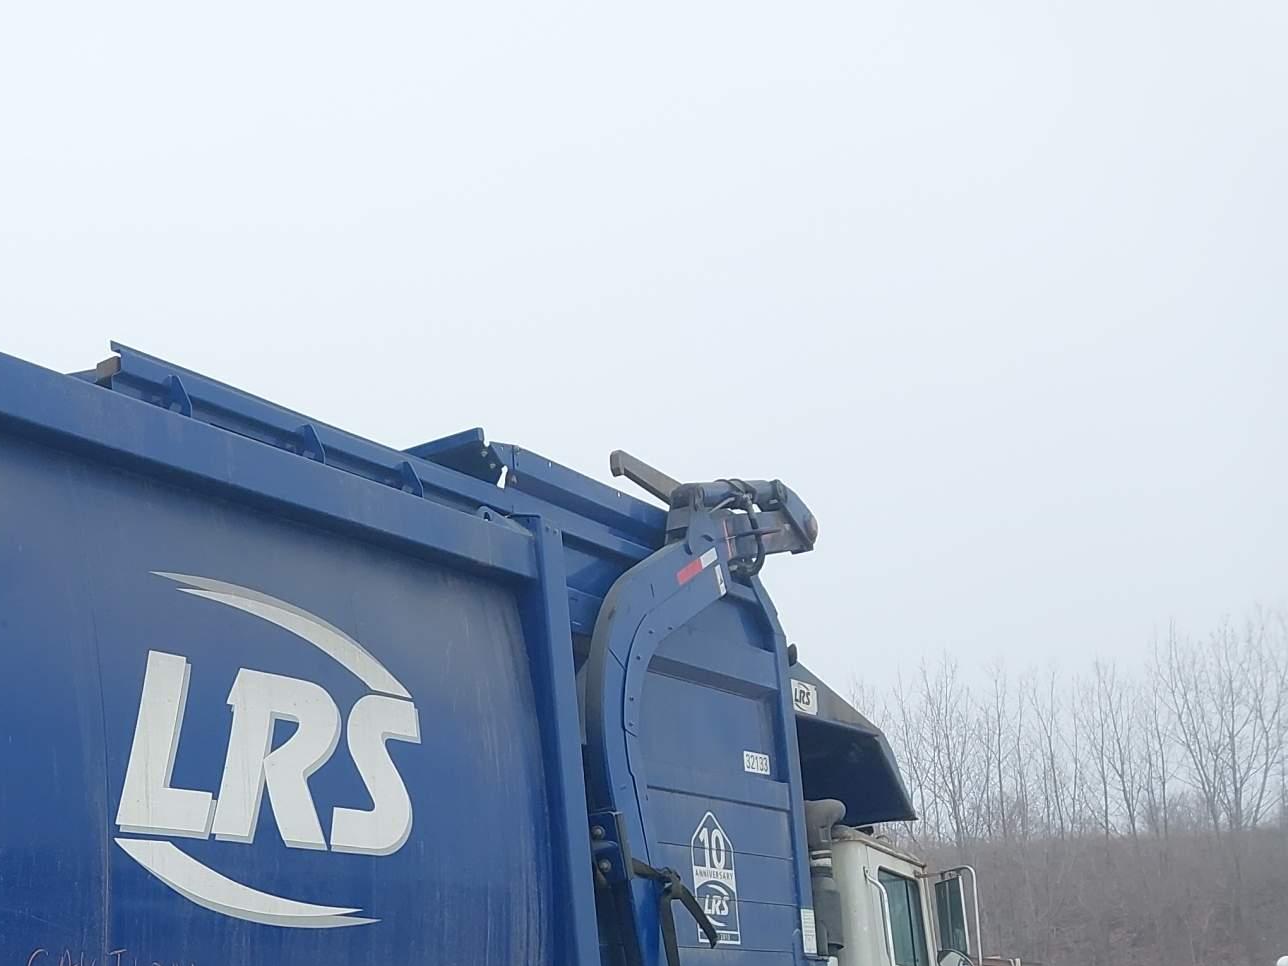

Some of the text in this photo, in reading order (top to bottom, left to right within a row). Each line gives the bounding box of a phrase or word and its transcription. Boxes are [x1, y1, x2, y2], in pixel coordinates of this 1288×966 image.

[795, 688, 810, 705] LRS
[115, 650, 421, 857] LRS
[745, 753, 769, 773] 32133
[699, 827, 726, 870] 10
[695, 869, 734, 881] ANNIVERSARY
[704, 895, 730, 916] LRS
